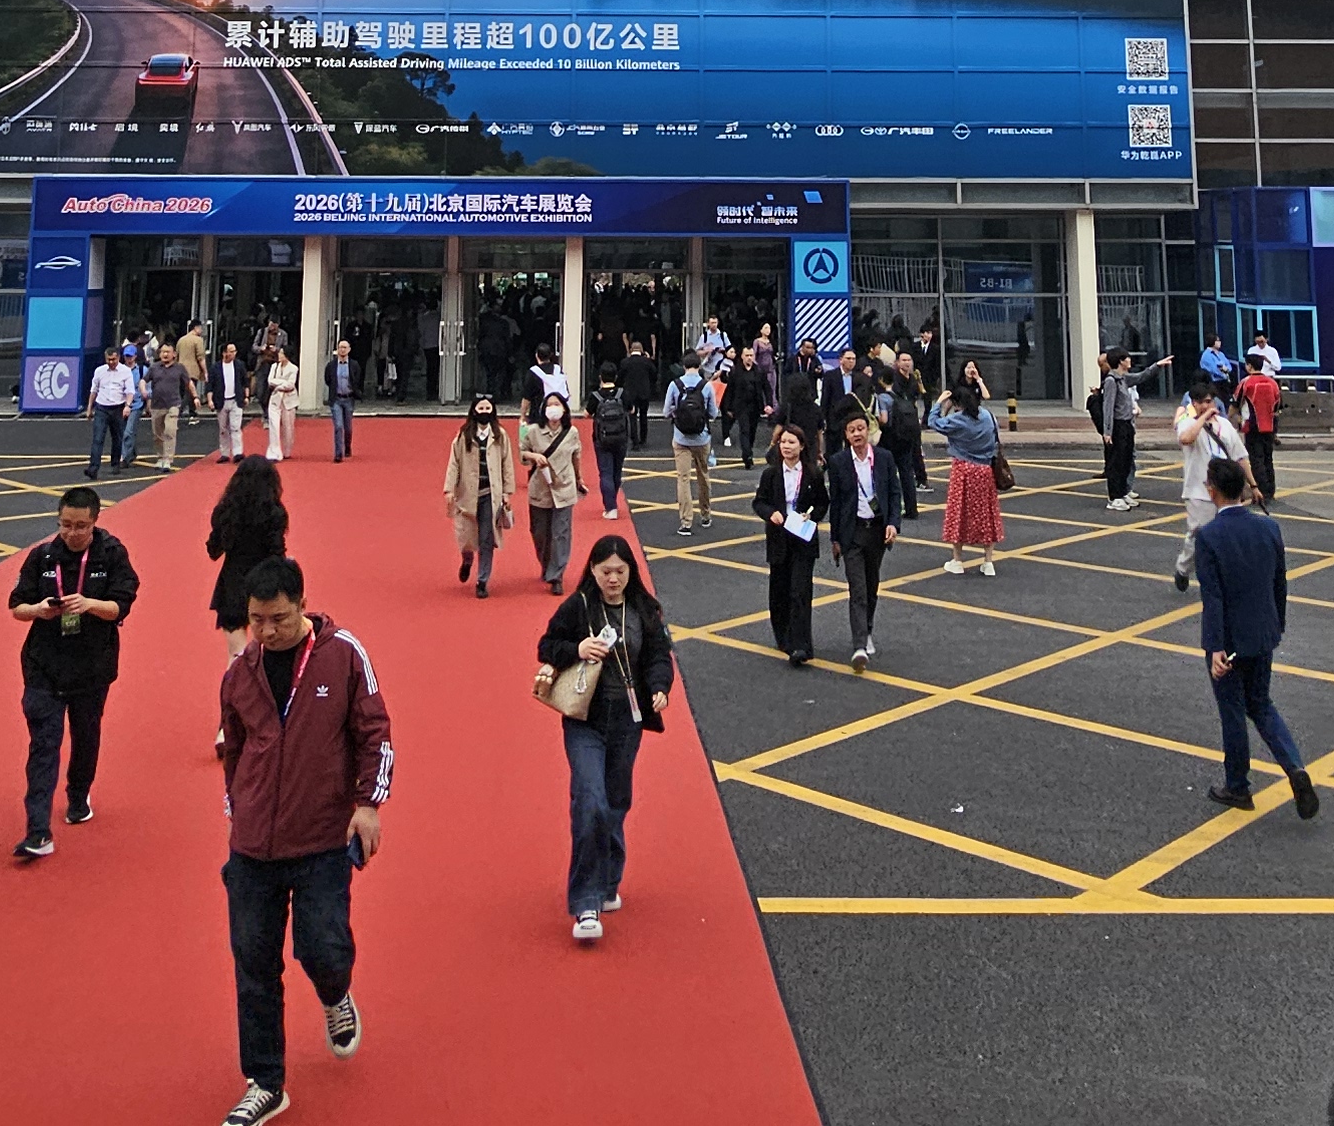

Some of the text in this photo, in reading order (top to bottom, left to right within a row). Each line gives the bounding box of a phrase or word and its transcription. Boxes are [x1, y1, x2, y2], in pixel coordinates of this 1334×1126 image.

[223, 20, 681, 51] 累计辅助驾驶里程超100亿公里
[223, 57, 274, 68] HUAWEI
[315, 57, 346, 68] Total
[349, 57, 397, 68] Assisted
[400, 58, 445, 71] Driving
[447, 58, 496, 70] Mileage
[499, 58, 554, 69] Exceeded
[557, 59, 572, 69] 10
[575, 58, 613, 70] Billion
[616, 59, 680, 70] Kilometers
[987, 127, 1053, 135] FREELANDER
[61, 194, 213, 214] Auto China 2026
[293, 193, 592, 213] 2026(第十九届)北京国际汽车展览会
[293, 213, 593, 223] 2026 BEIJING INTERNATIONAL AUTOMOTIVE EXHIBITION
[753, 217, 798, 226] Intelligence
